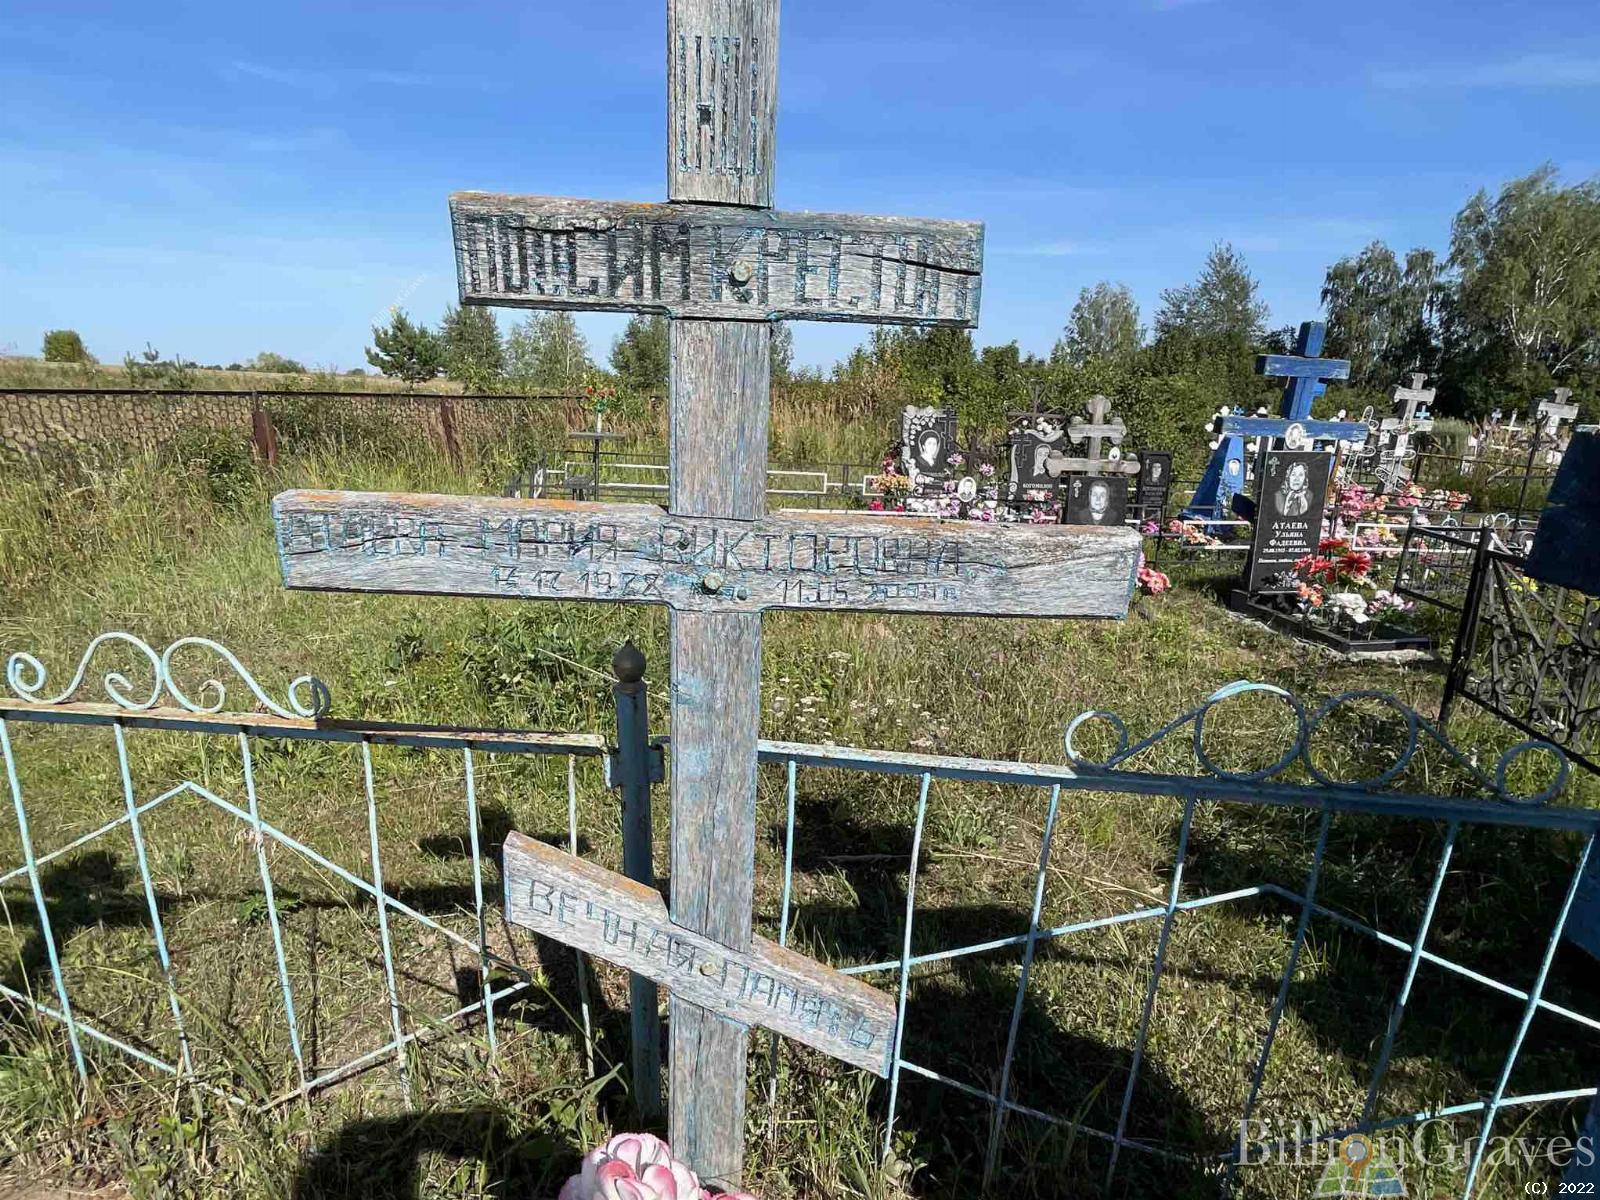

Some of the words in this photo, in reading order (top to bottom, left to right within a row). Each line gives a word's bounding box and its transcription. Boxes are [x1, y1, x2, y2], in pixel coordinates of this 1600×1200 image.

[480, 518, 619, 562] МАРИЯ
[659, 523, 960, 576] ВИКТОРОВНА
[1272, 521, 1309, 530] АТАЕВА
[529, 879, 696, 975] ВЕЧНАЯ
[720, 958, 876, 1050] ПАМЯТЬ
